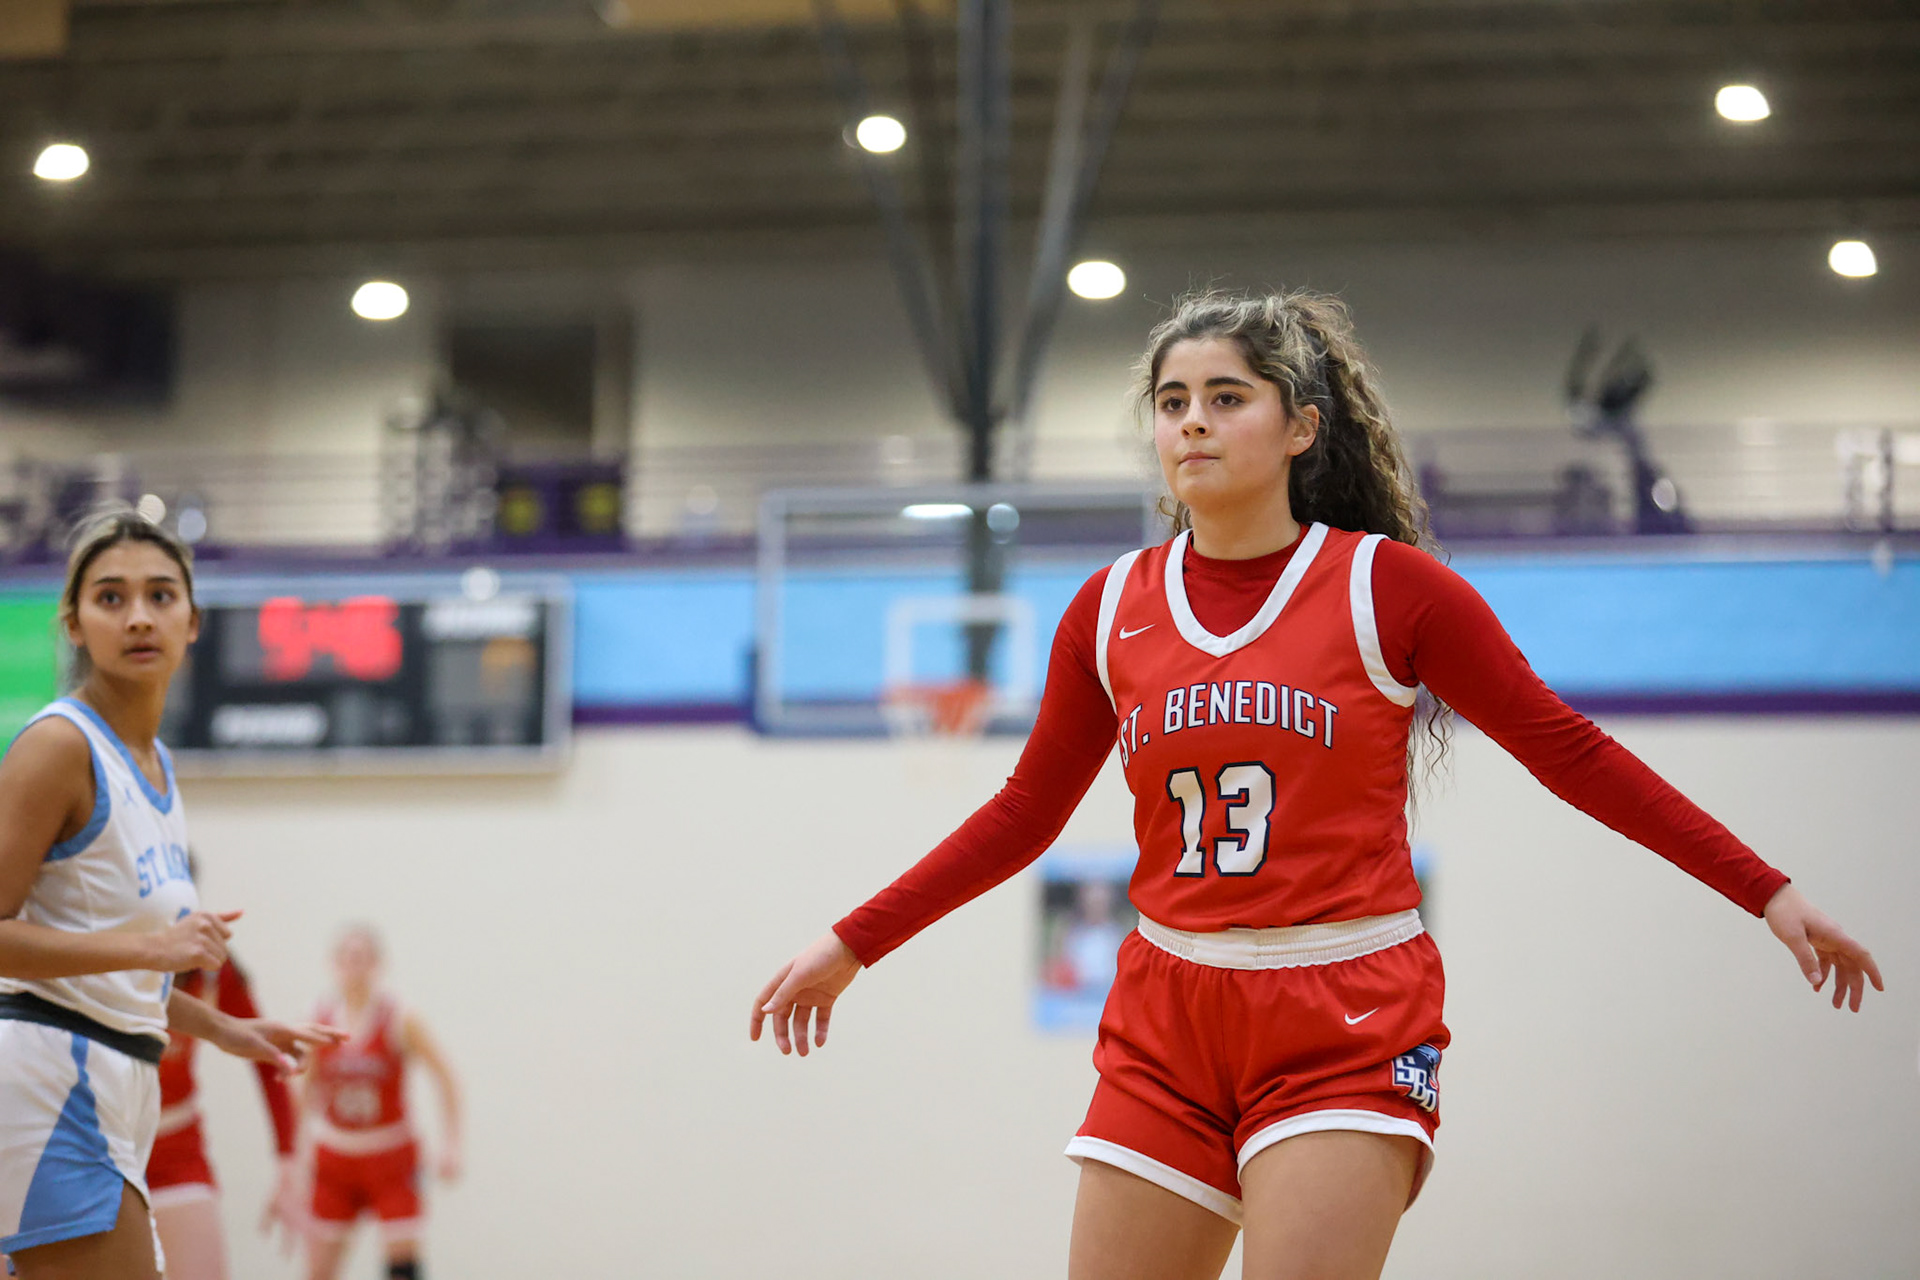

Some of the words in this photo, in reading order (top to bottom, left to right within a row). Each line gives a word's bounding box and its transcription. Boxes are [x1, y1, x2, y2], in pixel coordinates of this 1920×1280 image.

[1119, 703, 1150, 768] ST.
[1163, 680, 1338, 749] BENEDICT
[1166, 761, 1276, 878] 13
